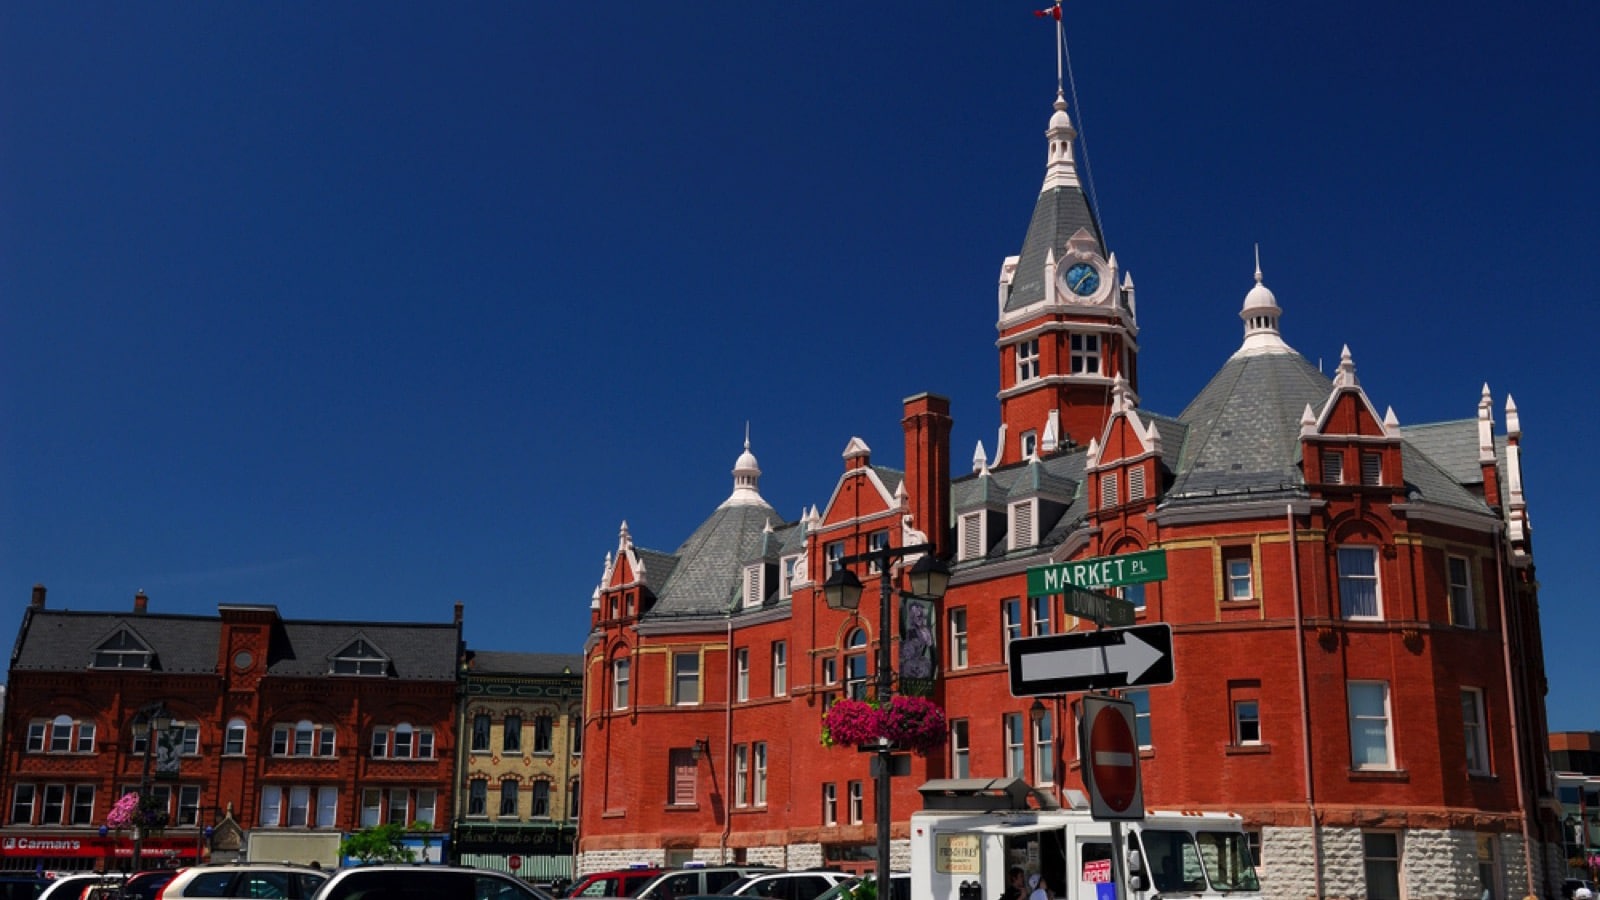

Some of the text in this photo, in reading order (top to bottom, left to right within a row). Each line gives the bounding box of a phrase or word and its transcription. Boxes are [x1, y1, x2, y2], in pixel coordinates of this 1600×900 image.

[1044, 559, 1125, 591] MARKET
[18, 838, 80, 849] Carman's
[1083, 869, 1110, 883] OPEN
